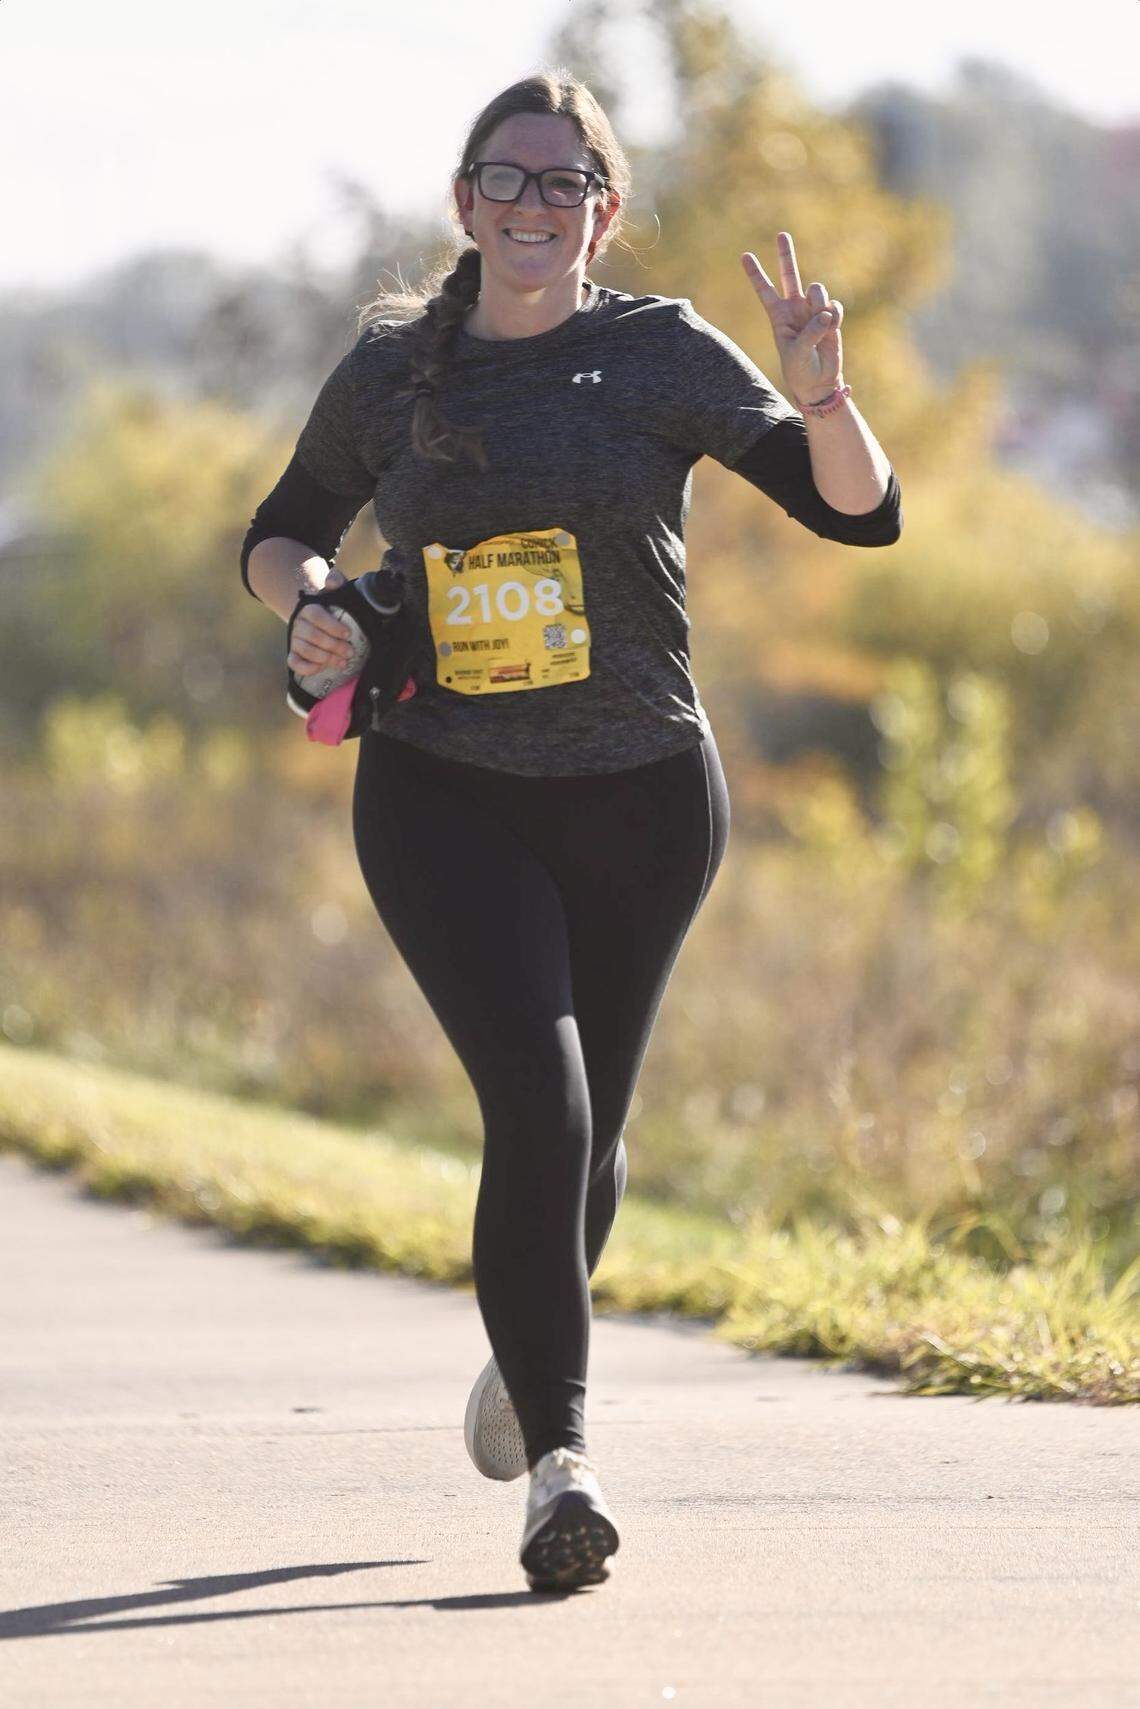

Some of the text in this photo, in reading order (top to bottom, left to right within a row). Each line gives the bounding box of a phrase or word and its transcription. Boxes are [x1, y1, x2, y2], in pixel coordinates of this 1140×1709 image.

[468, 550, 561, 570] HALF MARATHON
[446, 579, 564, 626] 2108
[452, 641, 468, 652] RUN
[470, 640, 490, 651] WITH
